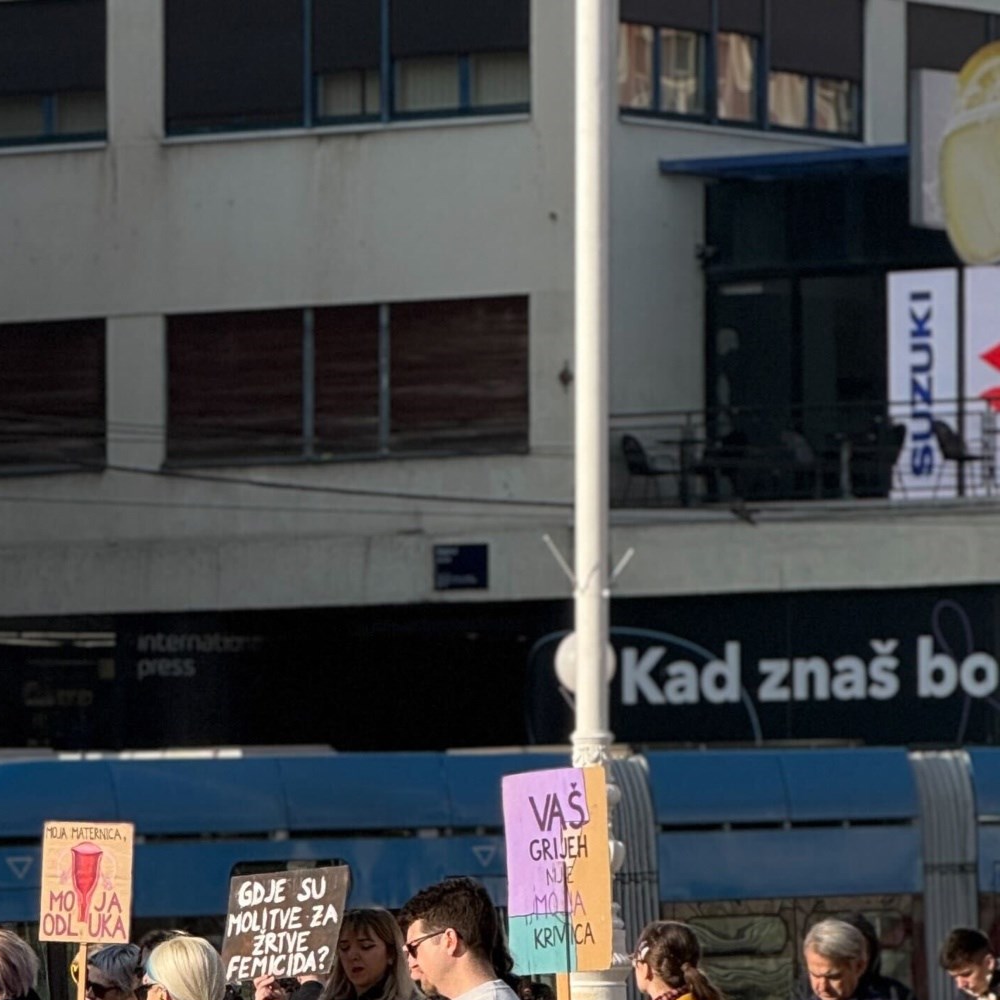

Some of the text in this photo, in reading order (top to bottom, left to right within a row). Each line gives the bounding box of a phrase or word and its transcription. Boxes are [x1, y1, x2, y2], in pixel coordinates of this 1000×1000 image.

[909, 290, 934, 477] SUZUKI
[137, 657, 197, 681] press
[620, 634, 999, 705] Kad znaš bo
[528, 781, 586, 832] VAŠ
[45, 826, 67, 840] MOJA
[529, 834, 589, 862] GRIJEH
[238, 875, 327, 908] GDJE SU
[227, 904, 338, 938] MOLITVE ZA
[252, 929, 311, 956] ŽRTVE
[226, 945, 330, 980] FEMICIDA?
